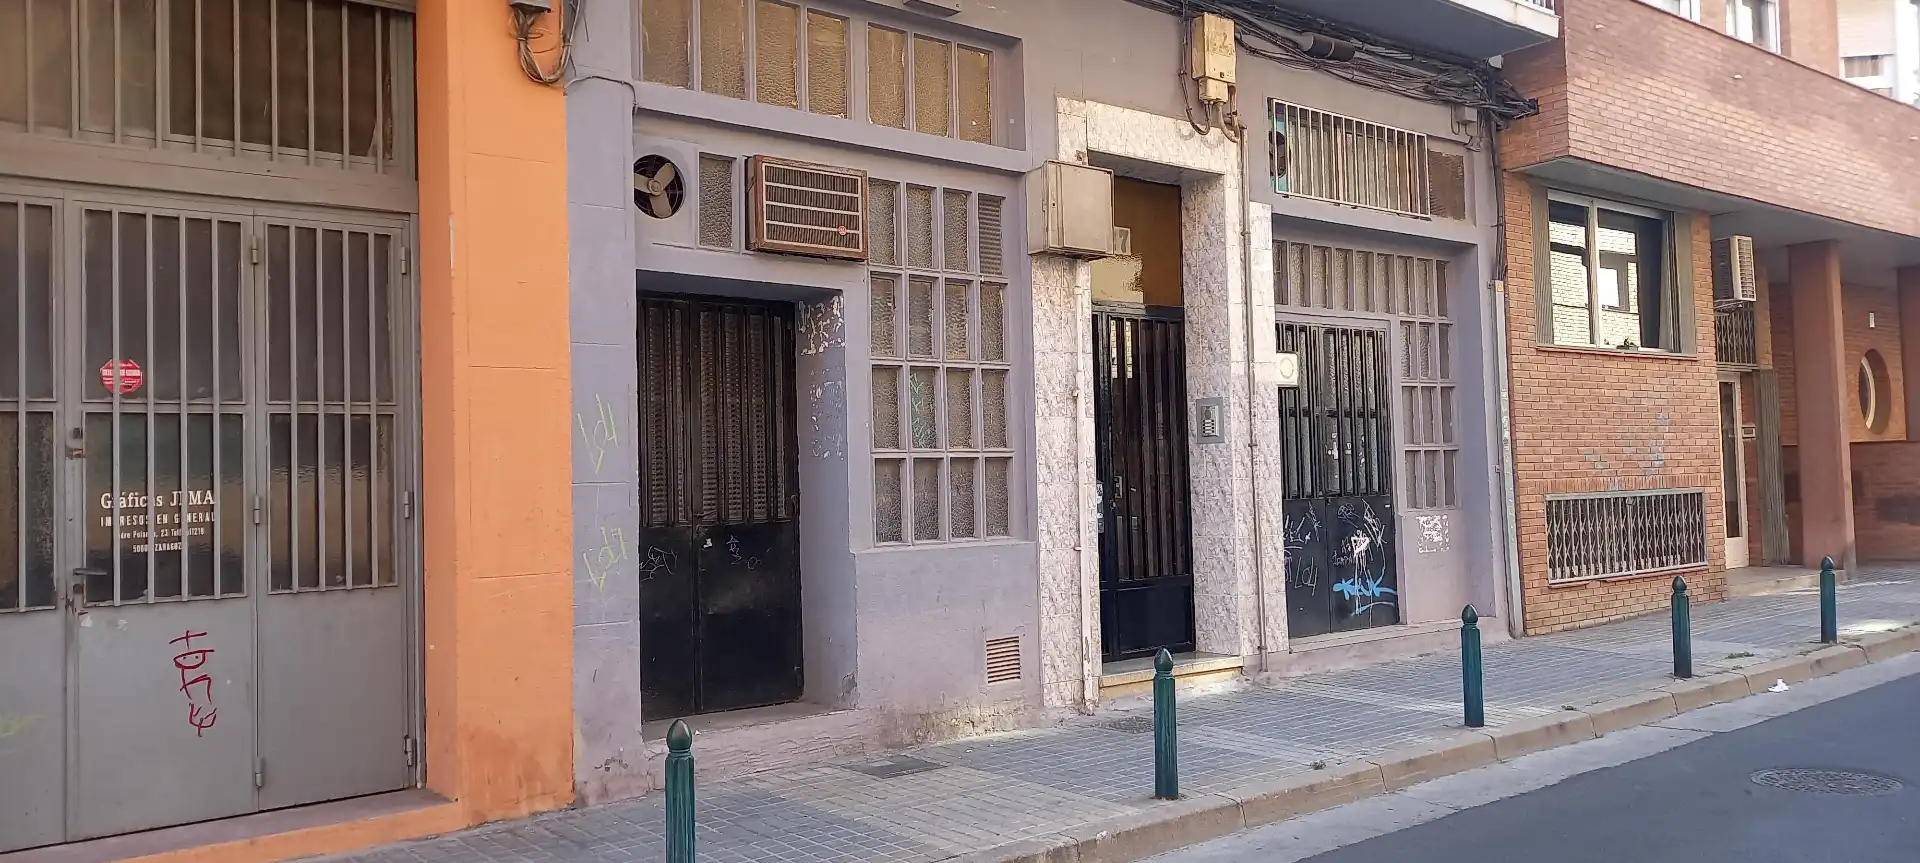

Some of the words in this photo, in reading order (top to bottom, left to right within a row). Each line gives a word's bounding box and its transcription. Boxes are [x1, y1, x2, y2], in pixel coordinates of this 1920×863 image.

[101, 491, 163, 508] Gáfics
[156, 513, 168, 524] EN
[174, 511, 215, 524] GNERAL
